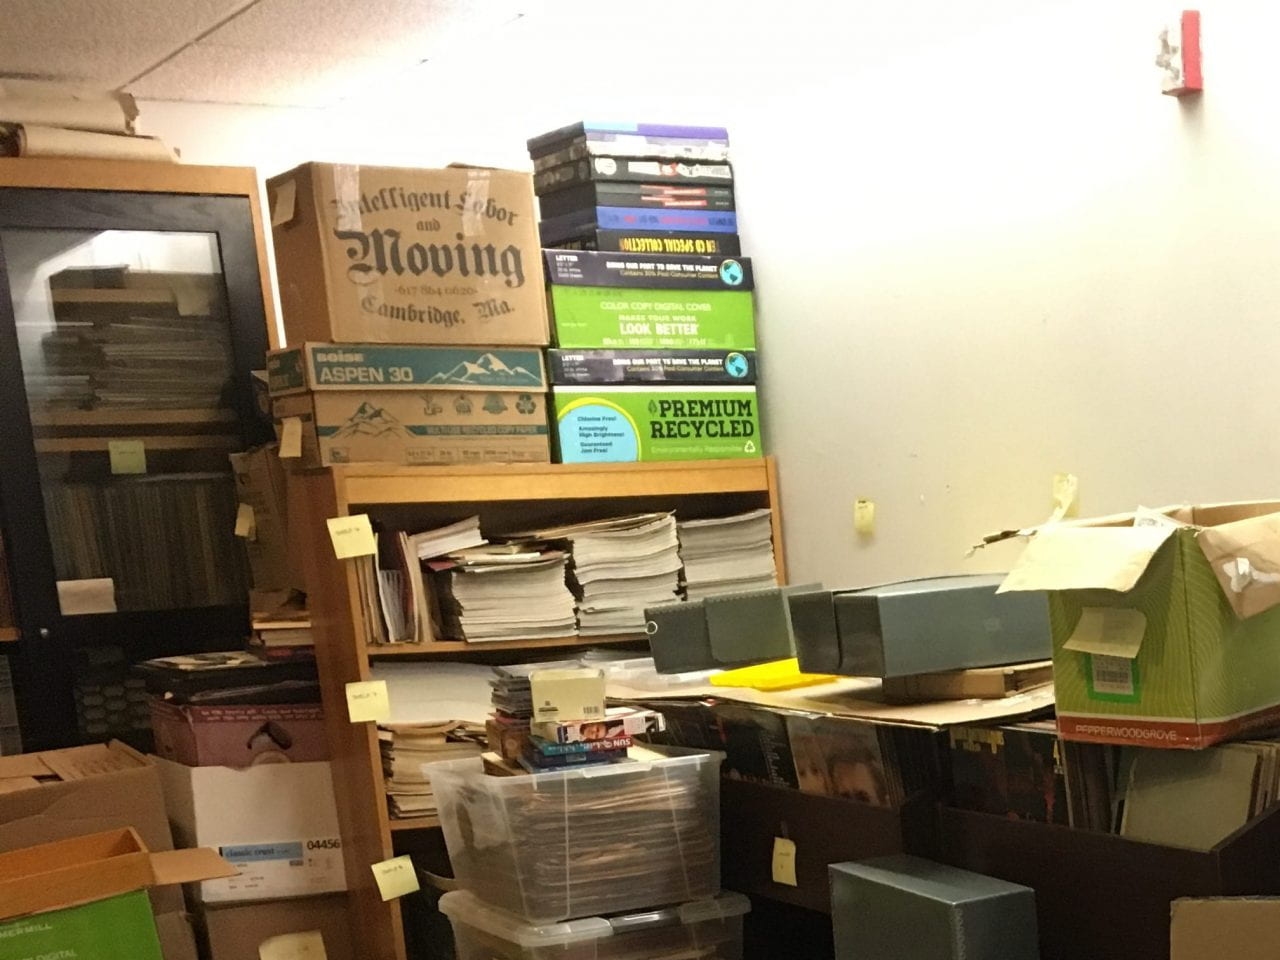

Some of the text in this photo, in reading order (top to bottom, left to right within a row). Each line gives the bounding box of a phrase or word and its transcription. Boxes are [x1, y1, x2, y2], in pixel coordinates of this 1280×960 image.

[416, 218, 442, 232] and
[664, 239, 694, 253] SPECIAL
[333, 226, 526, 288] Moving
[620, 323, 699, 336] LOOK BETTER
[320, 366, 414, 383] ASPEN 30
[659, 400, 753, 418] PREMIUM
[651, 420, 755, 439] RECYCLED
[613, 737, 632, 748] SUN
[306, 838, 341, 851] 04456
